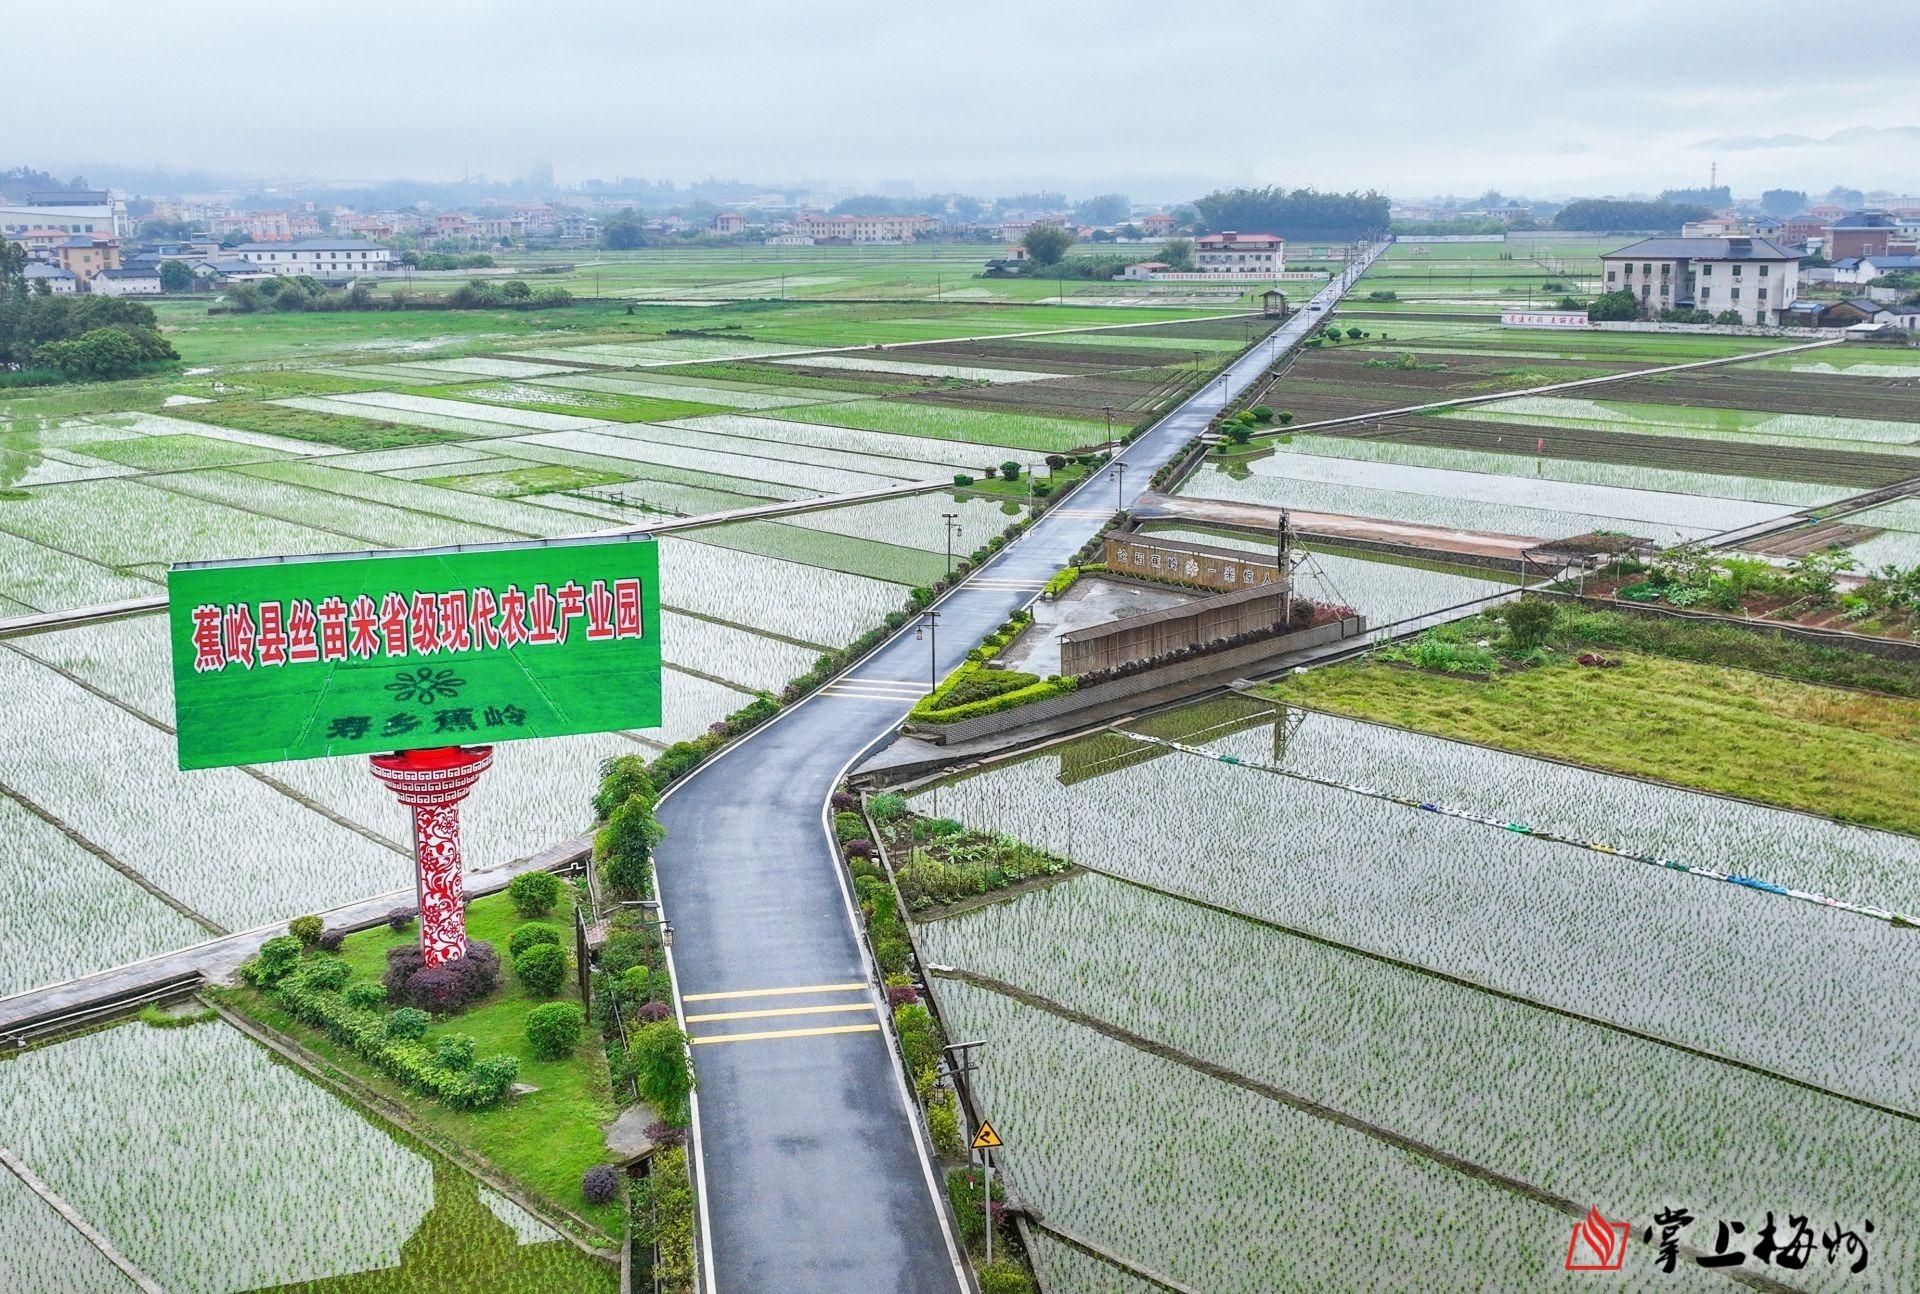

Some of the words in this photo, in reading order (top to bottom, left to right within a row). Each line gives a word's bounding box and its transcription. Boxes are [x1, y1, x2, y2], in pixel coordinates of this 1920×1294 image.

[192, 577, 644, 672] 蕉岭县丝苗米省级现代农业产业园
[325, 703, 527, 740] 寿乡蕉岭
